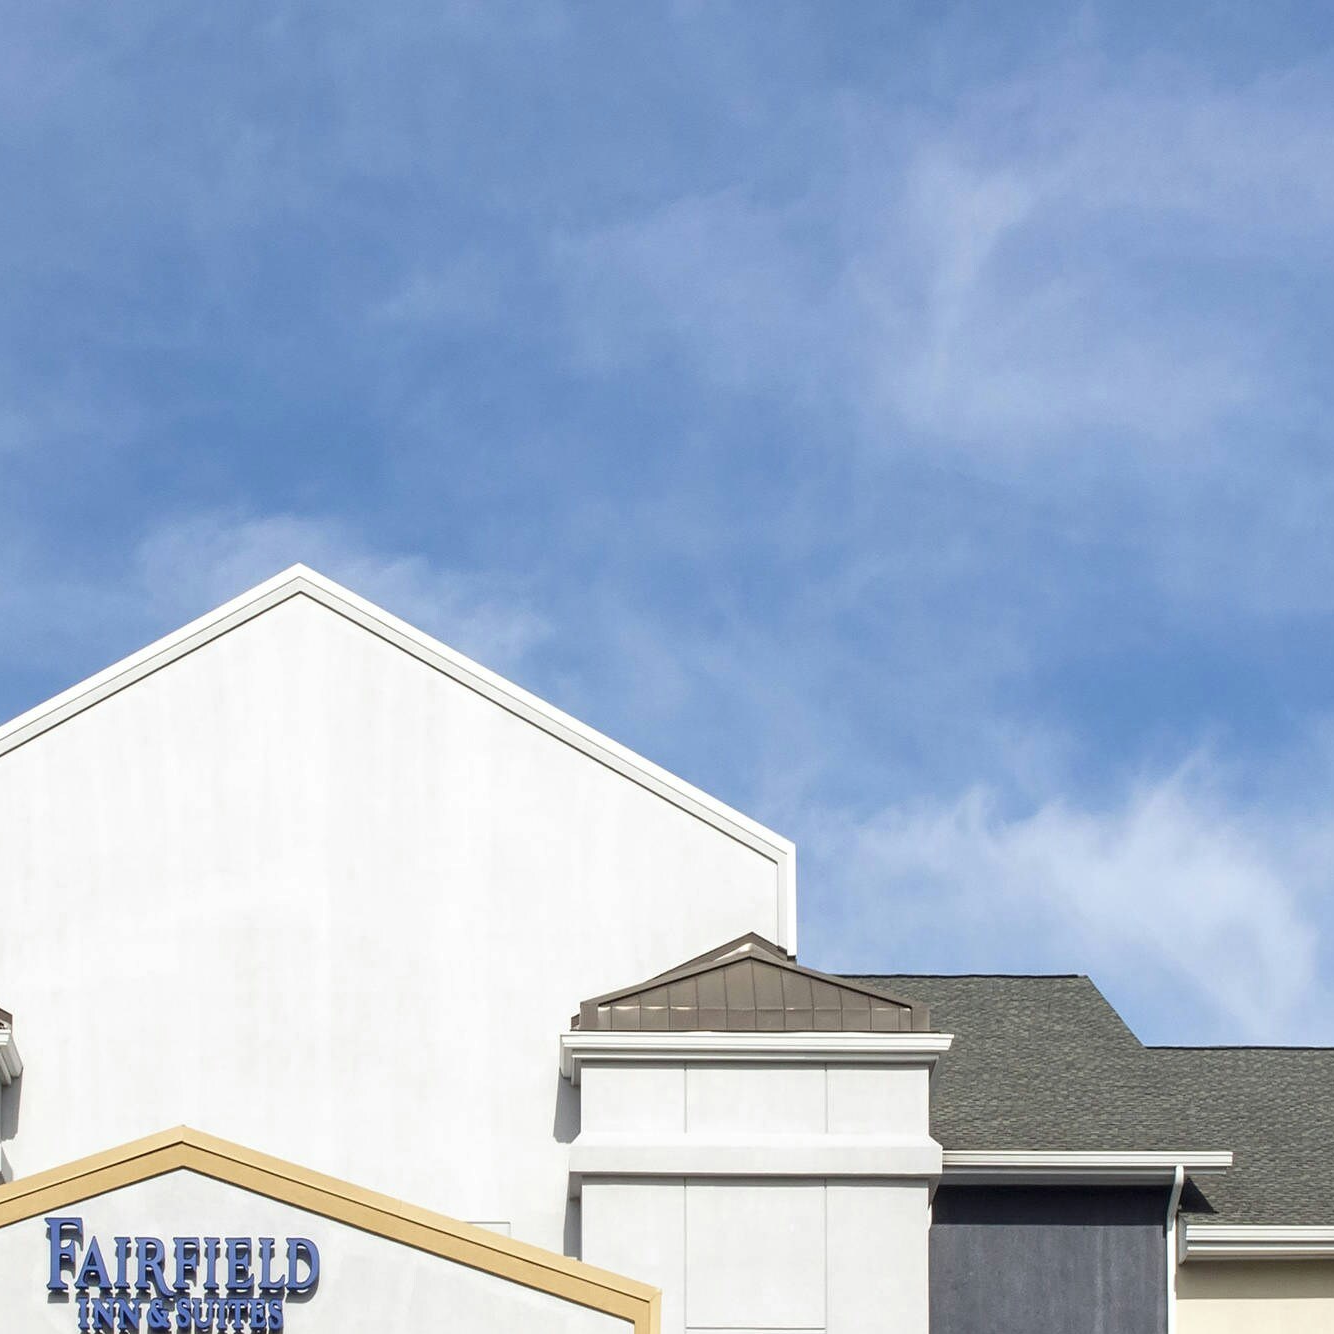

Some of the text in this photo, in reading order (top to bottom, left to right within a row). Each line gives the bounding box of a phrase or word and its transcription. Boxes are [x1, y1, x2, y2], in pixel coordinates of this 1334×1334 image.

[44, 1217, 320, 1297] FAIRFIELD
[77, 1297, 284, 1333] INN & SUITES
